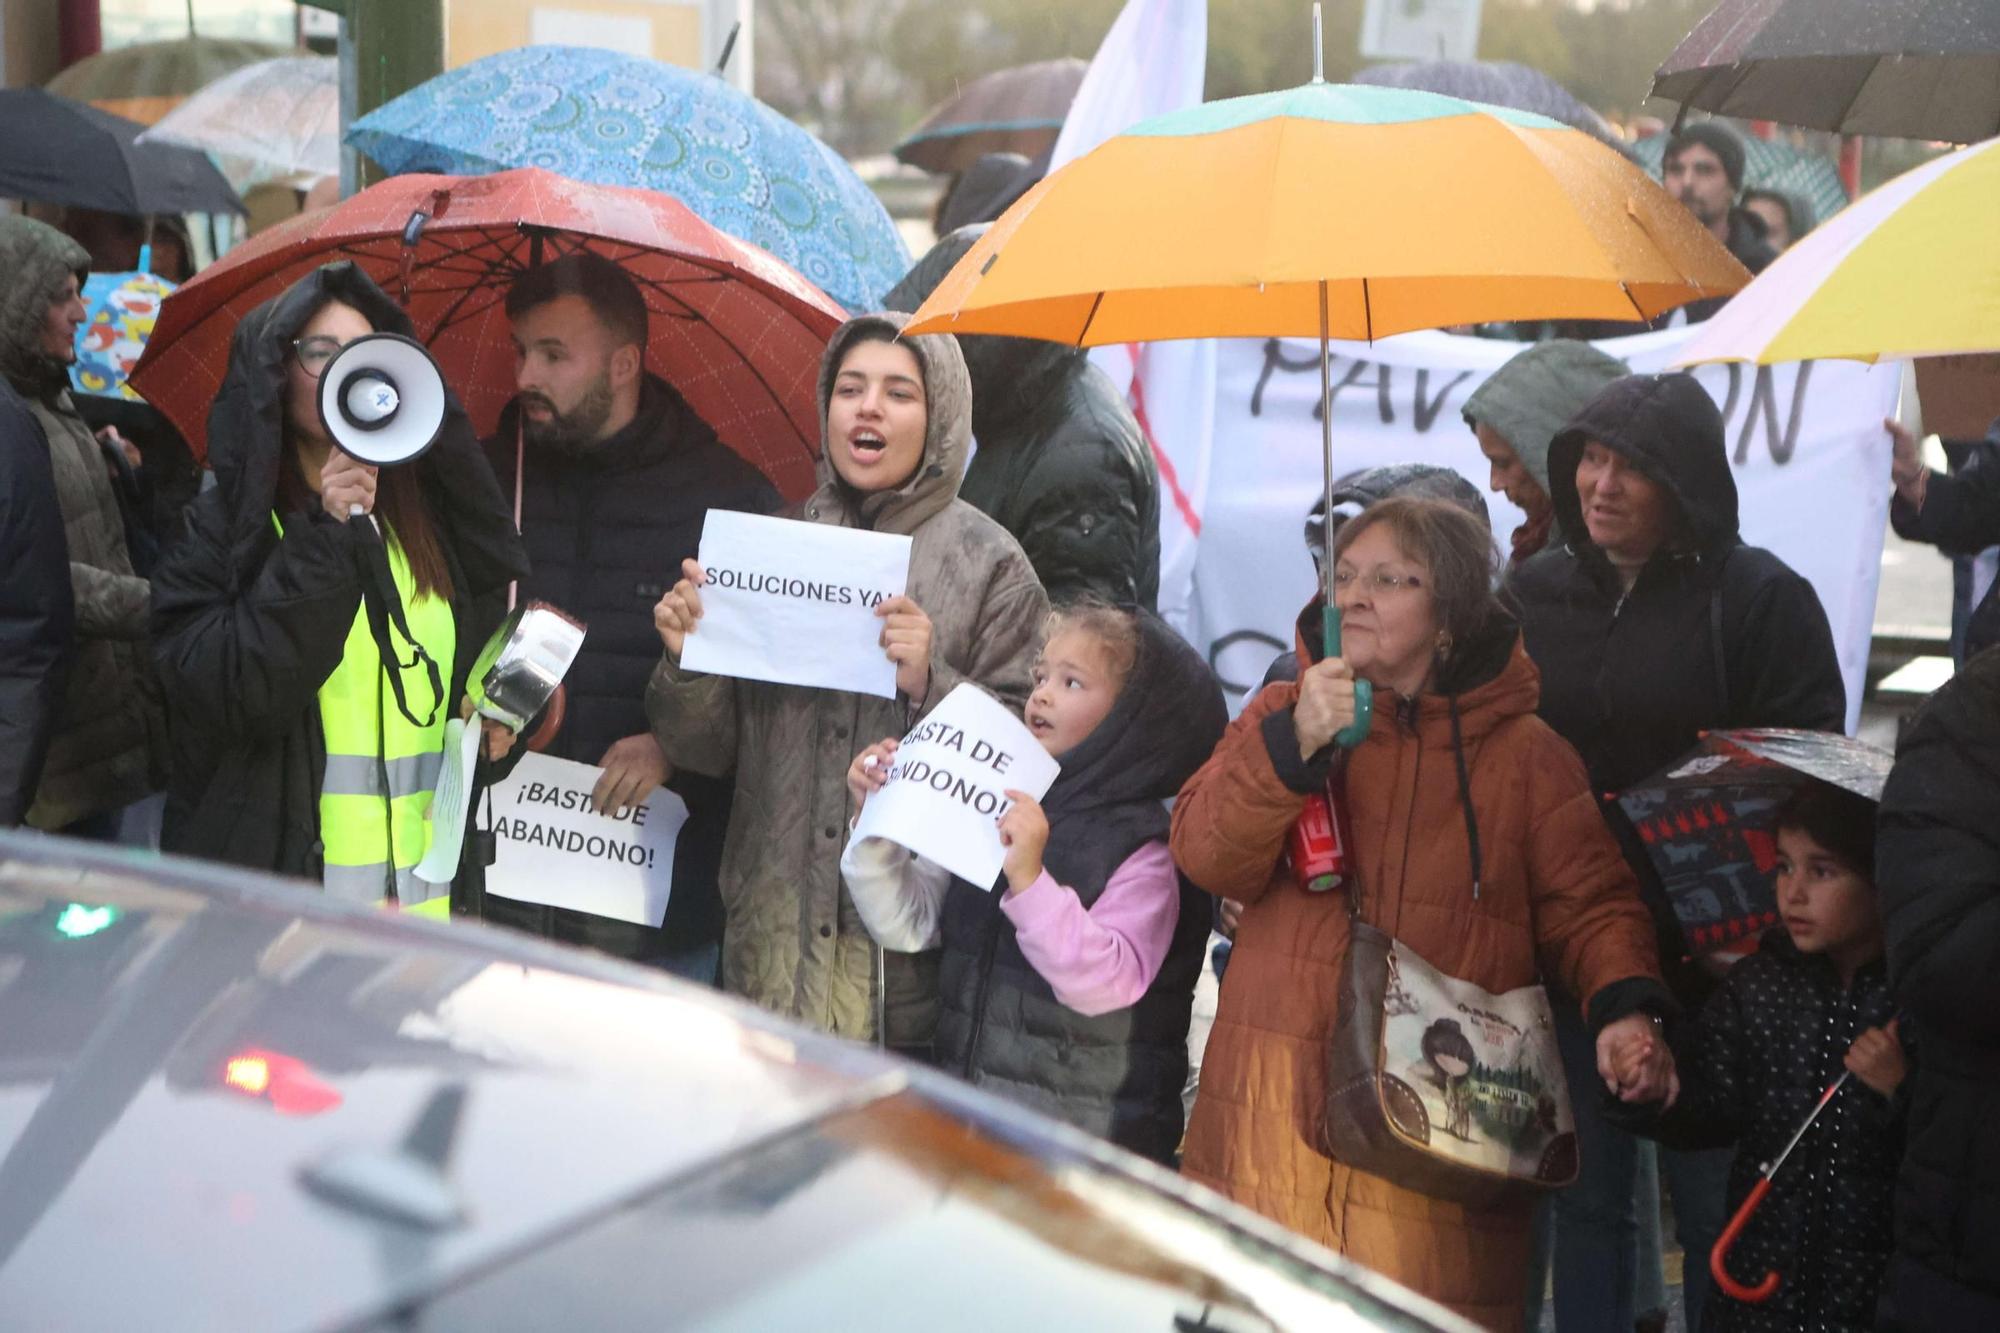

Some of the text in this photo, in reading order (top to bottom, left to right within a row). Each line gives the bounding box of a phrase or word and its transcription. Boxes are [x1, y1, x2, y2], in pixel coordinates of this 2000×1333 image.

[697, 566, 852, 605] SOLUCIONES
[969, 739, 1014, 775] DE
[493, 816, 655, 869] ABANDONO!
